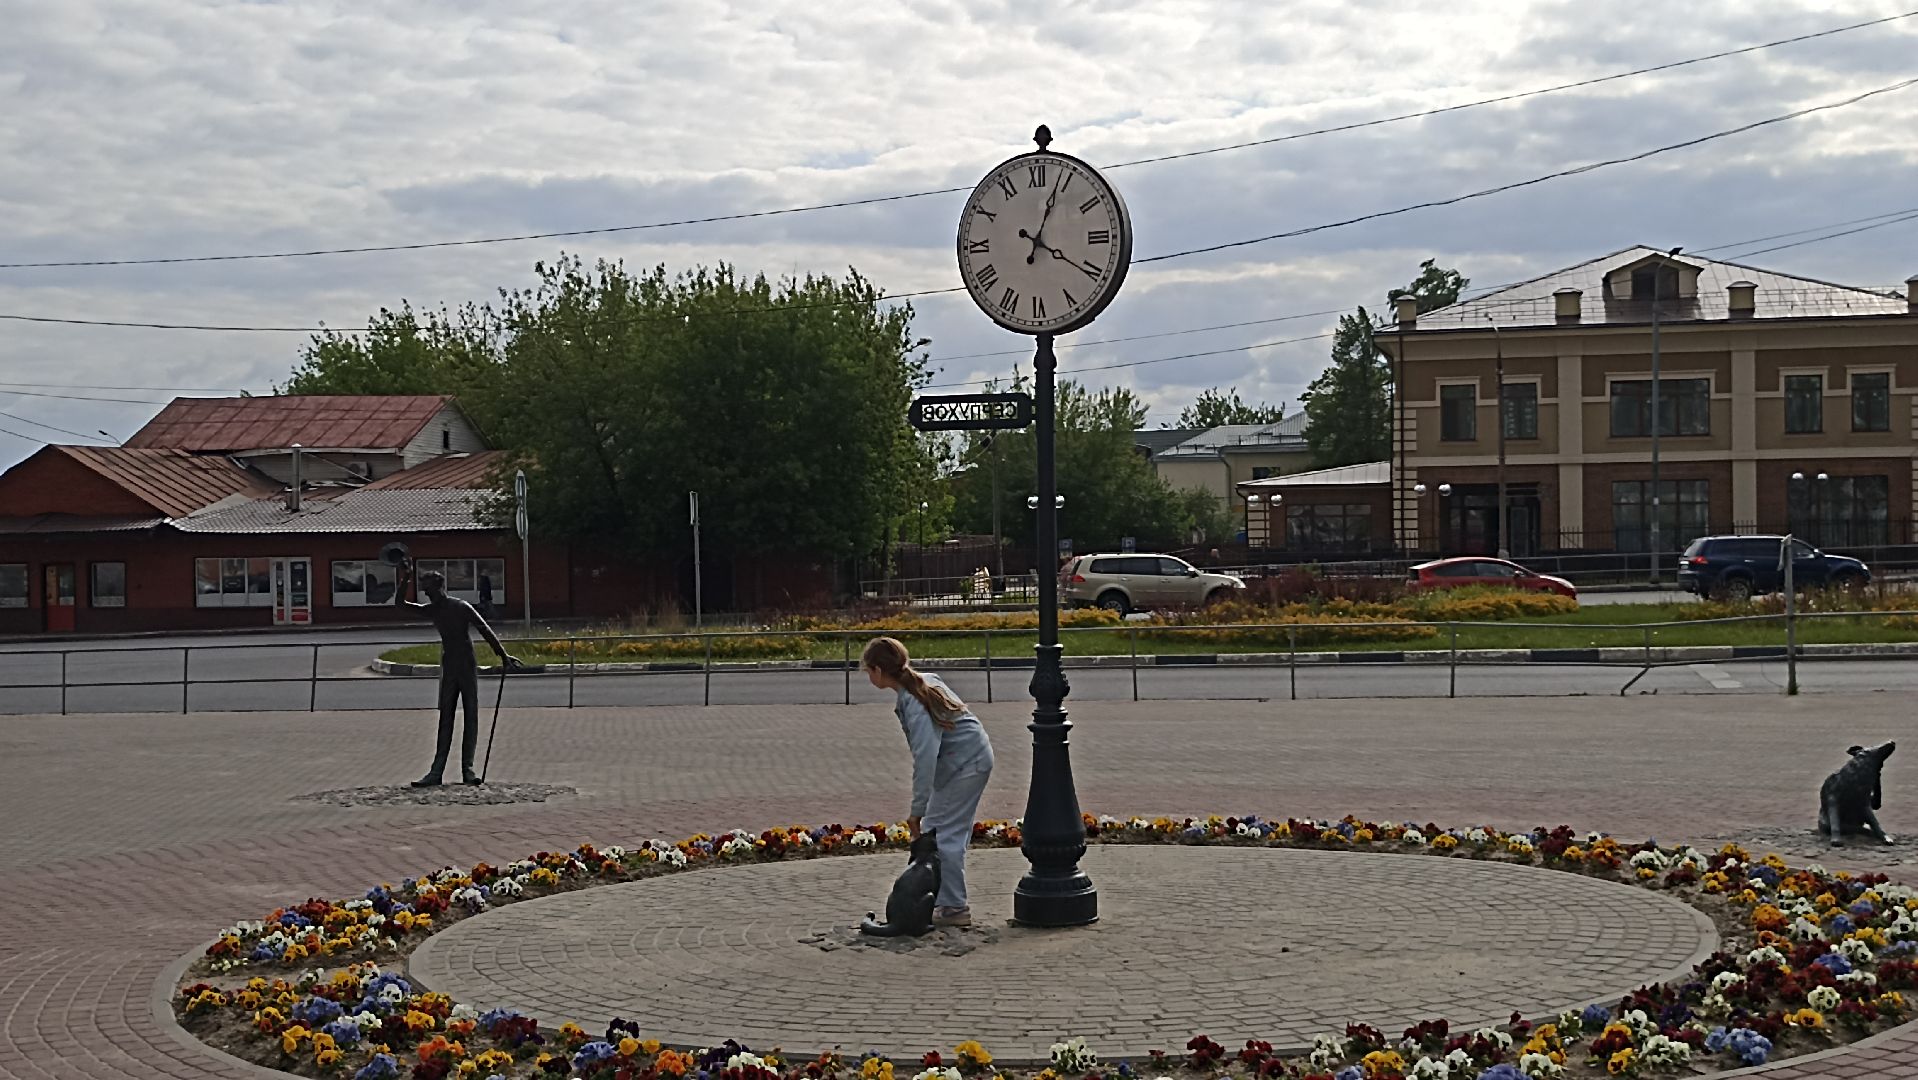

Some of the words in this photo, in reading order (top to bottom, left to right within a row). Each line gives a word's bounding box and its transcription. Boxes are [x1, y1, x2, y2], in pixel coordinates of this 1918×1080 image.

[1028, 165, 1045, 188] XII
[1061, 172, 1073, 192] I
[998, 176, 1017, 200] XI
[976, 205, 997, 223] X
[1080, 196, 1100, 214] II
[970, 239, 989, 254] IX
[1088, 230, 1109, 245] III
[976, 264, 999, 292] VIII
[1000, 287, 1019, 314] VII
[1033, 296, 1046, 318] VI
[1063, 288, 1077, 308] V
